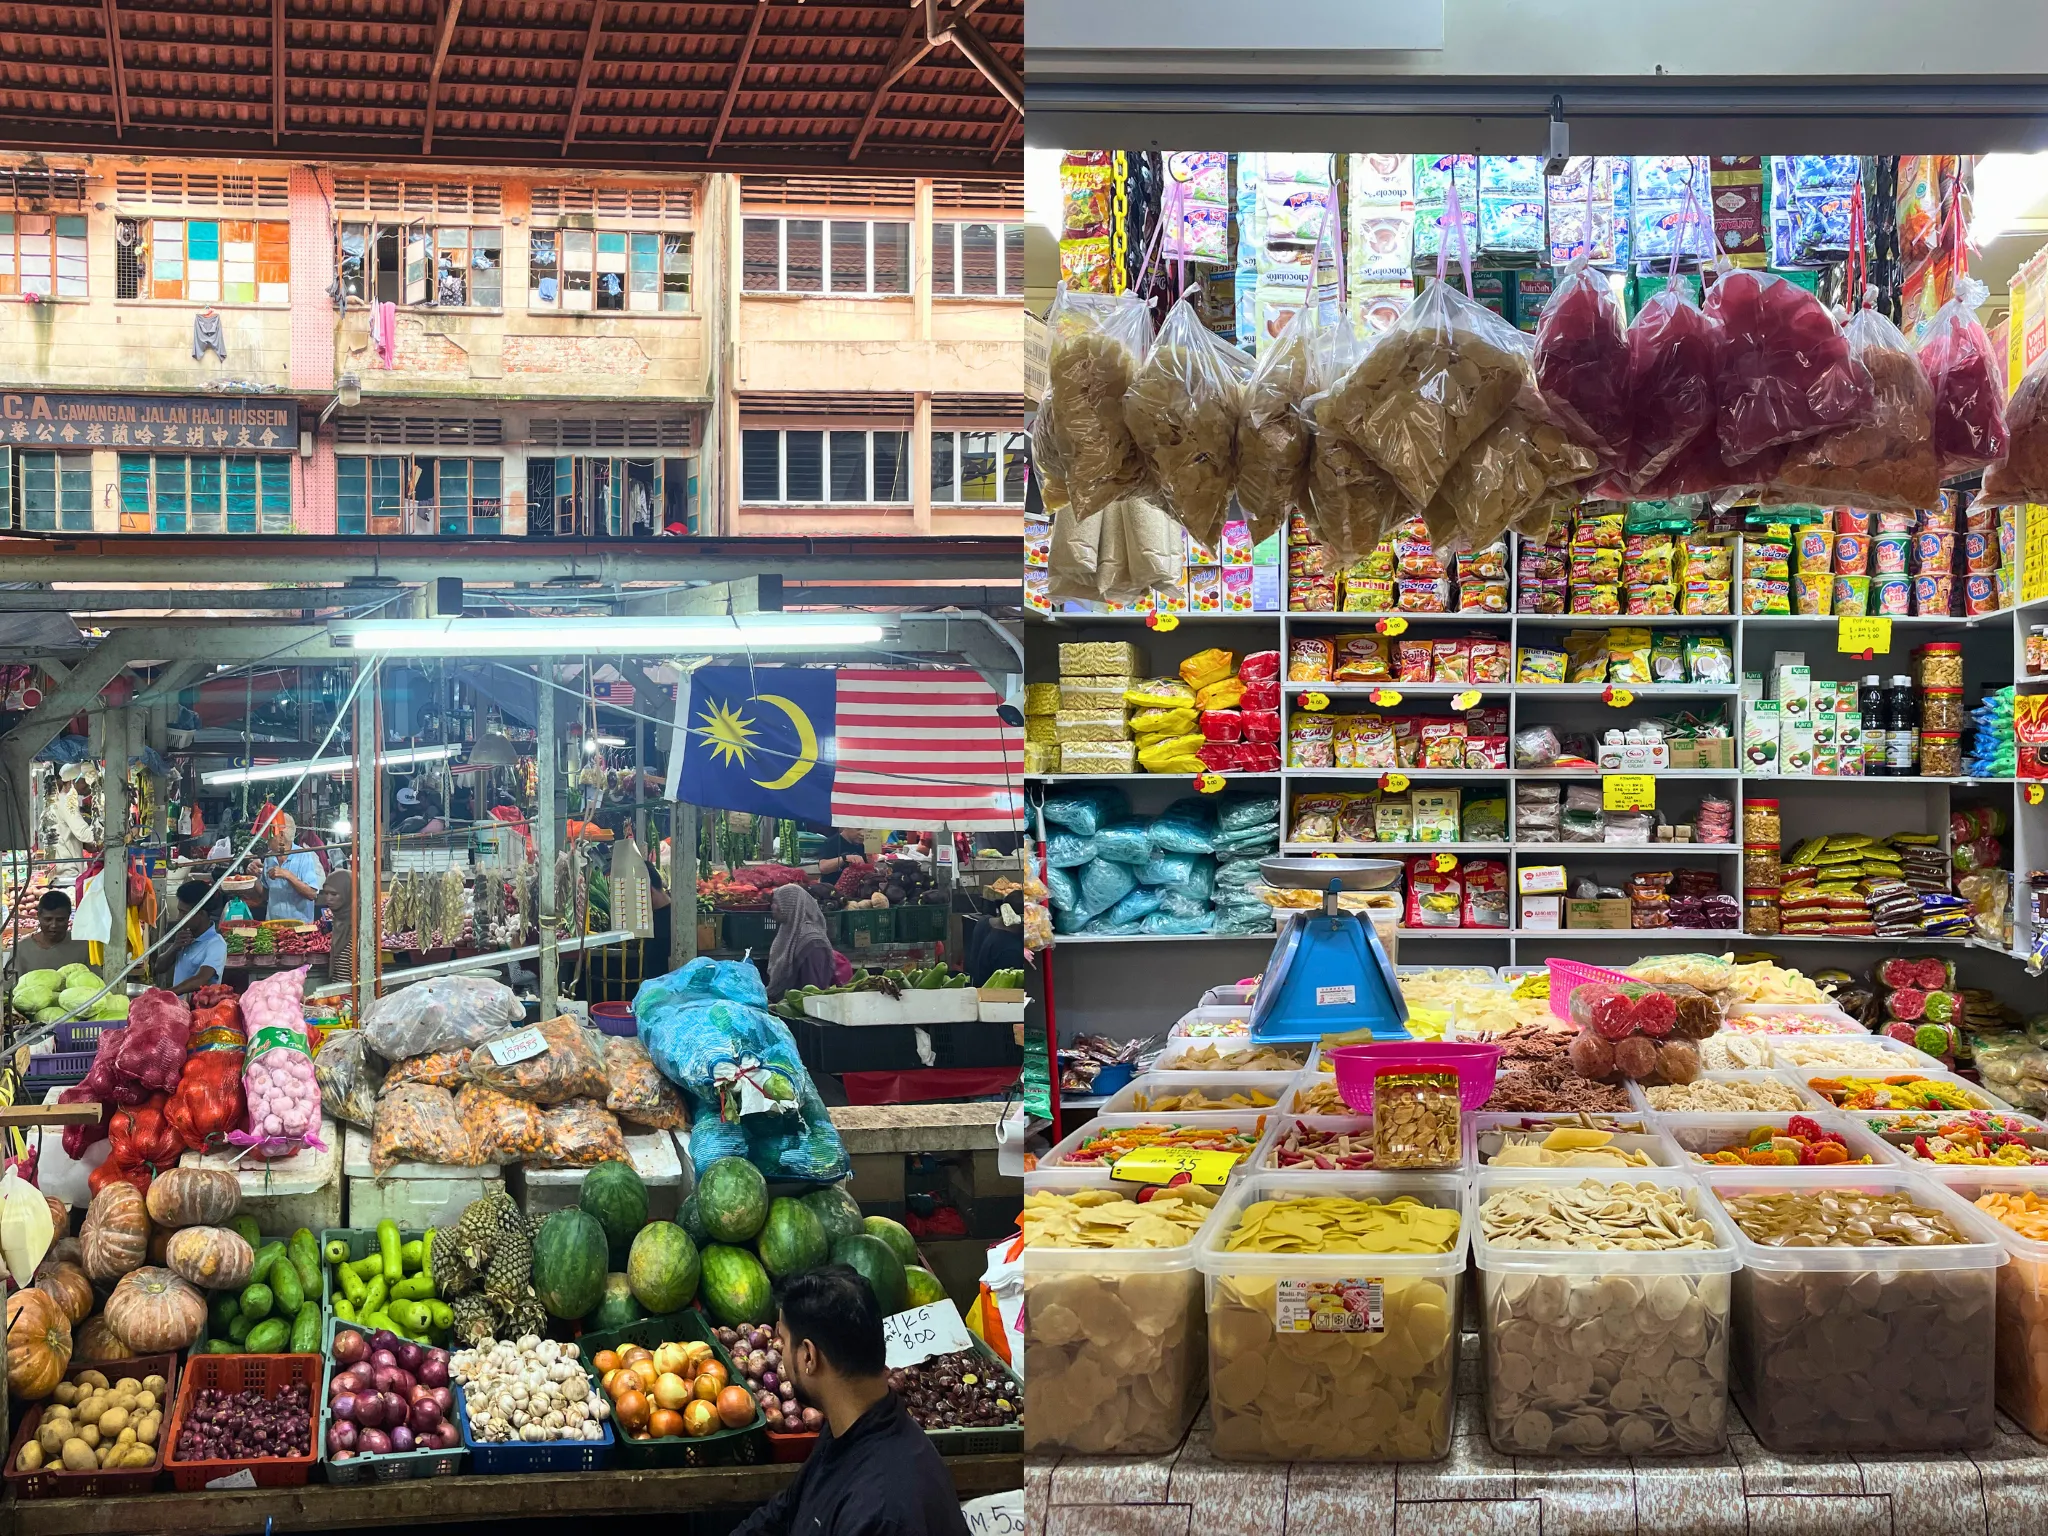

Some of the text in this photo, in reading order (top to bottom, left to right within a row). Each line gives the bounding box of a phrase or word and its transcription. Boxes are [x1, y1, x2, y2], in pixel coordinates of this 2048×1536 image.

[58, 404, 137, 423] CAWANGAN
[140, 406, 188, 424] JALAN
[191, 408, 224, 425] HAJI
[228, 408, 288, 426] HUSSEIN
[1805, 538, 1818, 548] POP
[1877, 545, 1894, 553] POP
[1970, 580, 1984, 589] POP
[1887, 585, 1903, 595] POP
[1291, 640, 1328, 656] Sajiku
[1473, 646, 1495, 655] Royco
[1523, 648, 1541, 656] Blue
[1792, 666, 1809, 674] kara
[1756, 702, 1777, 711] kara
[1675, 741, 1693, 750] kara
[903, 1328, 935, 1350] 8.00
